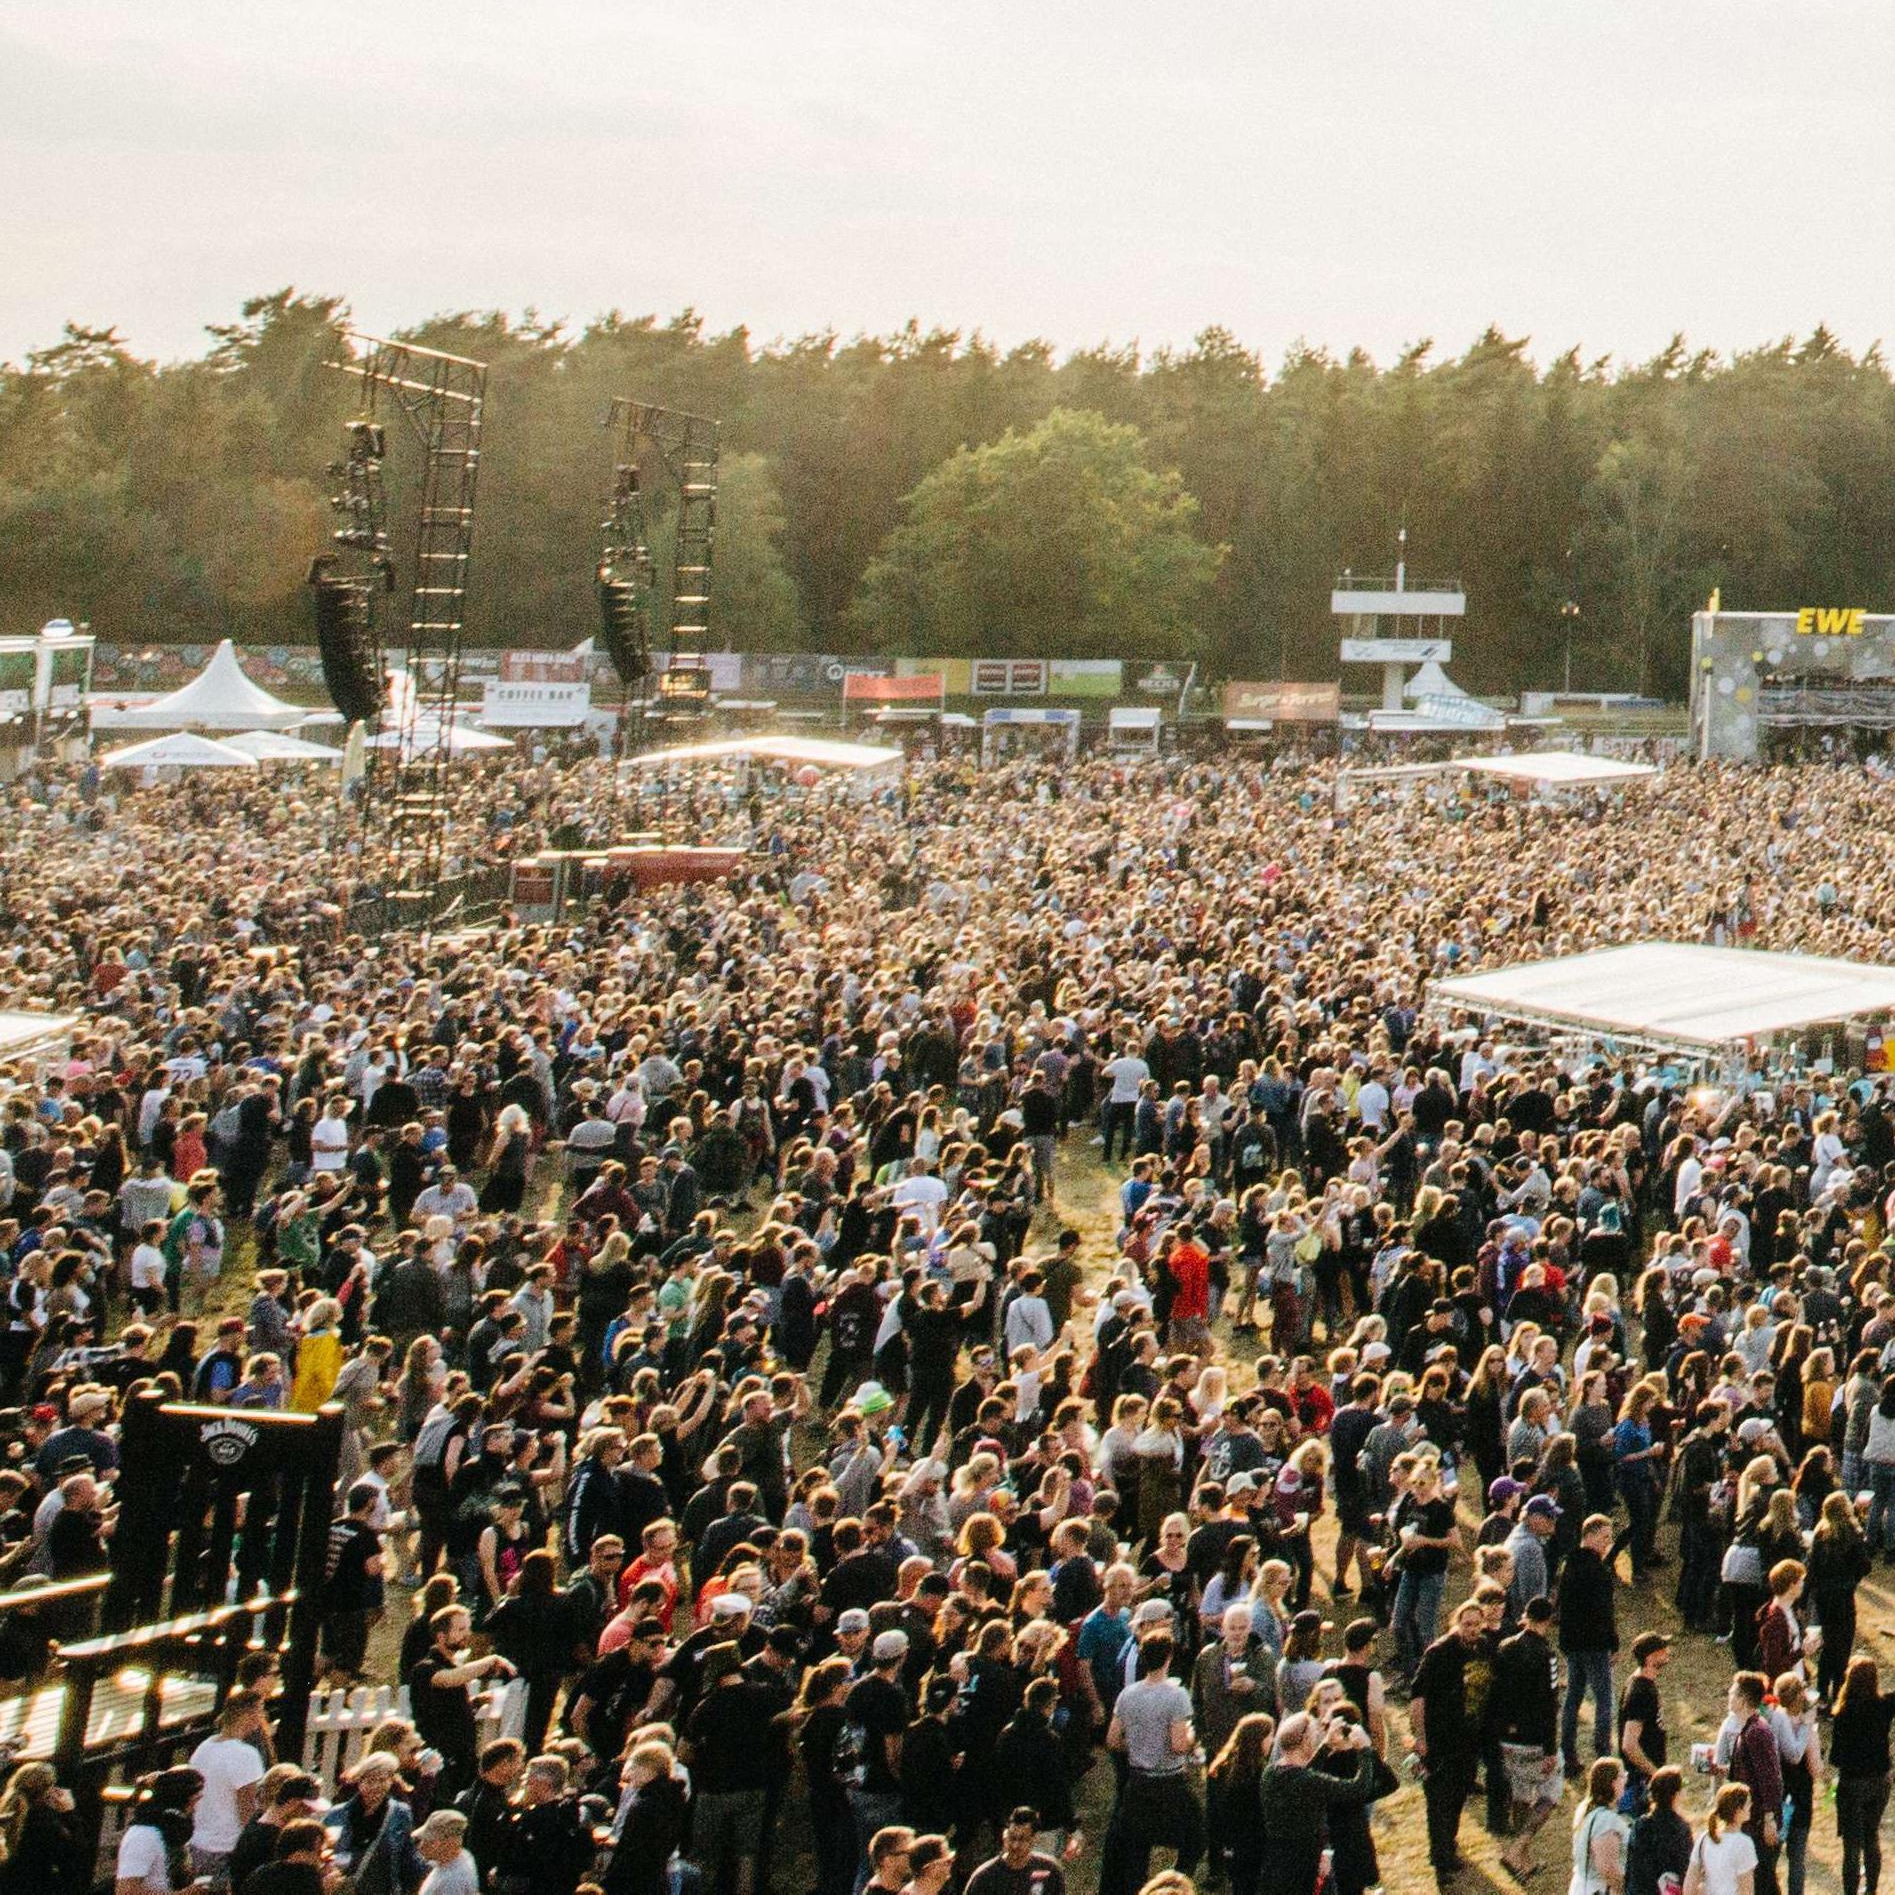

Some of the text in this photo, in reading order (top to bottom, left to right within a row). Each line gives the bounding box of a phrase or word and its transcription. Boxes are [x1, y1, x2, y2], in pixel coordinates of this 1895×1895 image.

[1796, 608, 1867, 635] EWE
[498, 690, 574, 700] COFFEE BAR
